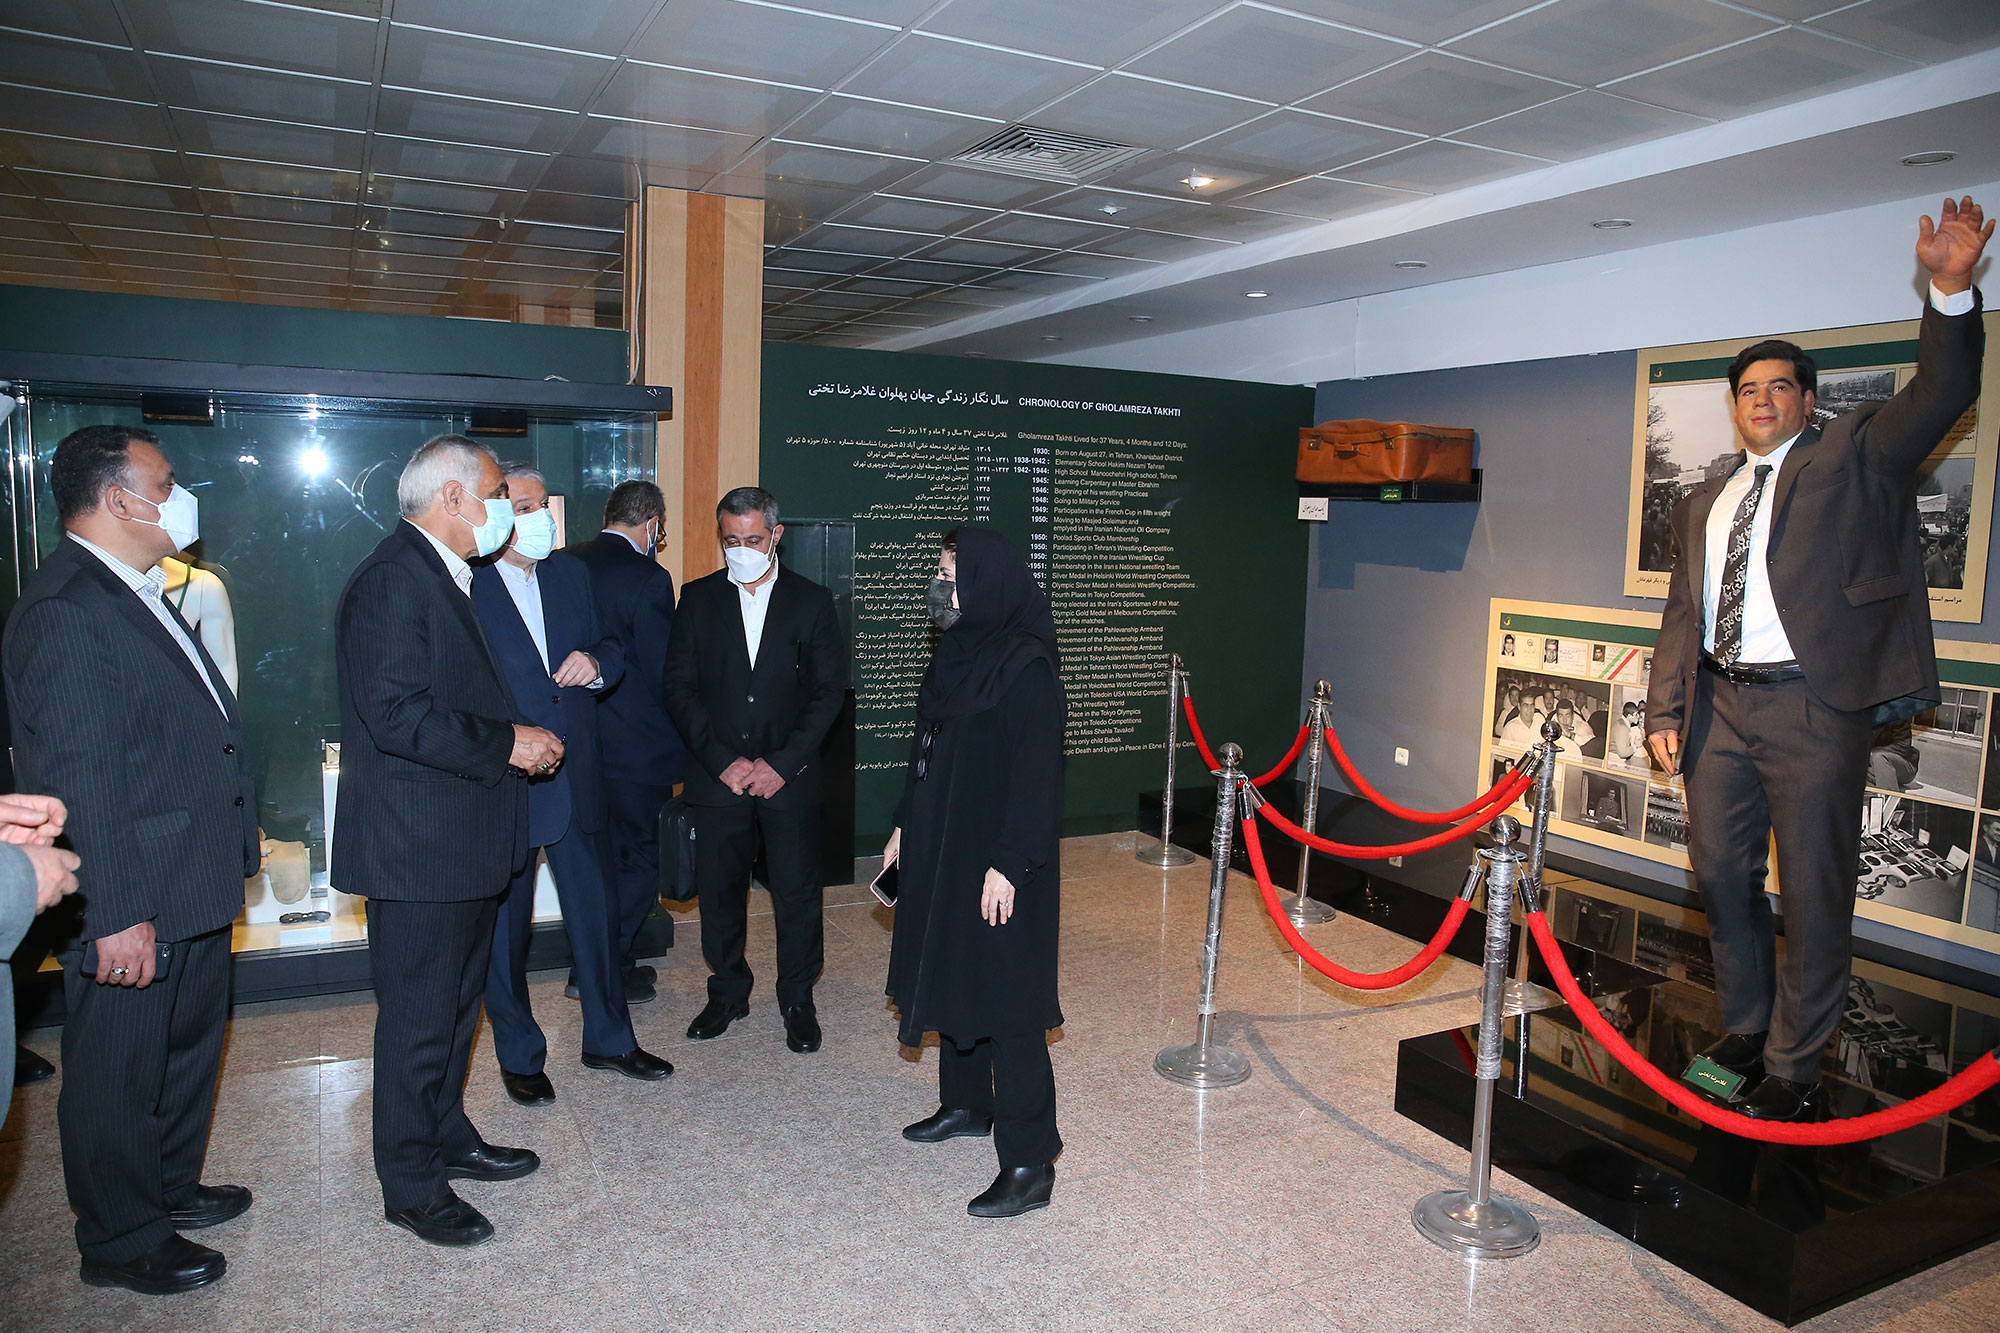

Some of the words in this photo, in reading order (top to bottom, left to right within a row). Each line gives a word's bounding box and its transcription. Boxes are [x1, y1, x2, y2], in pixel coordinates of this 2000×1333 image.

[808, 383, 835, 396] تختی
[837, 384, 877, 399] غلامرضا
[878, 386, 908, 403] پهلوان
[909, 388, 935, 403] جهان
[937, 389, 968, 404] زندگی
[969, 391, 989, 405] نگار
[990, 394, 1009, 406] سال
[1018, 397, 1080, 410] CHRONOLOGY
[1081, 401, 1094, 411] OF
[1095, 402, 1152, 415] GHOLAMREZA
[1152, 406, 1181, 417] TAKHTI
[1017, 431, 1055, 441] Gholamreza
[1055, 433, 1073, 442] Takhti
[1073, 435, 1090, 443] Lived
[1131, 438, 1152, 446] Months
[1055, 448, 1070, 456] Born
[1078, 450, 1098, 458] August
[1055, 459, 1087, 468] Elementary
[1054, 468, 1069, 477] High
[1126, 471, 1139, 479] High
[1054, 477, 1080, 486] Learning
[1054, 487, 1082, 497] Beginning
[1123, 490, 1149, 498] Practices
[1053, 496, 1071, 506] Going
[1079, 498, 1099, 507] Military
[1099, 498, 1120, 506] Service
[1053, 506, 1088, 515] Participation
[1105, 508, 1124, 516] French
[1124, 508, 1137, 517] Cup
[1053, 516, 1074, 525] Moving
[1113, 526, 1137, 534] National
[1145, 526, 1170, 535] Company
[1073, 535, 1092, 543] Sports
[1106, 535, 1140, 544] Membership
[1052, 553, 1092, 562] Championship
[1153, 554, 1165, 562] Cup
